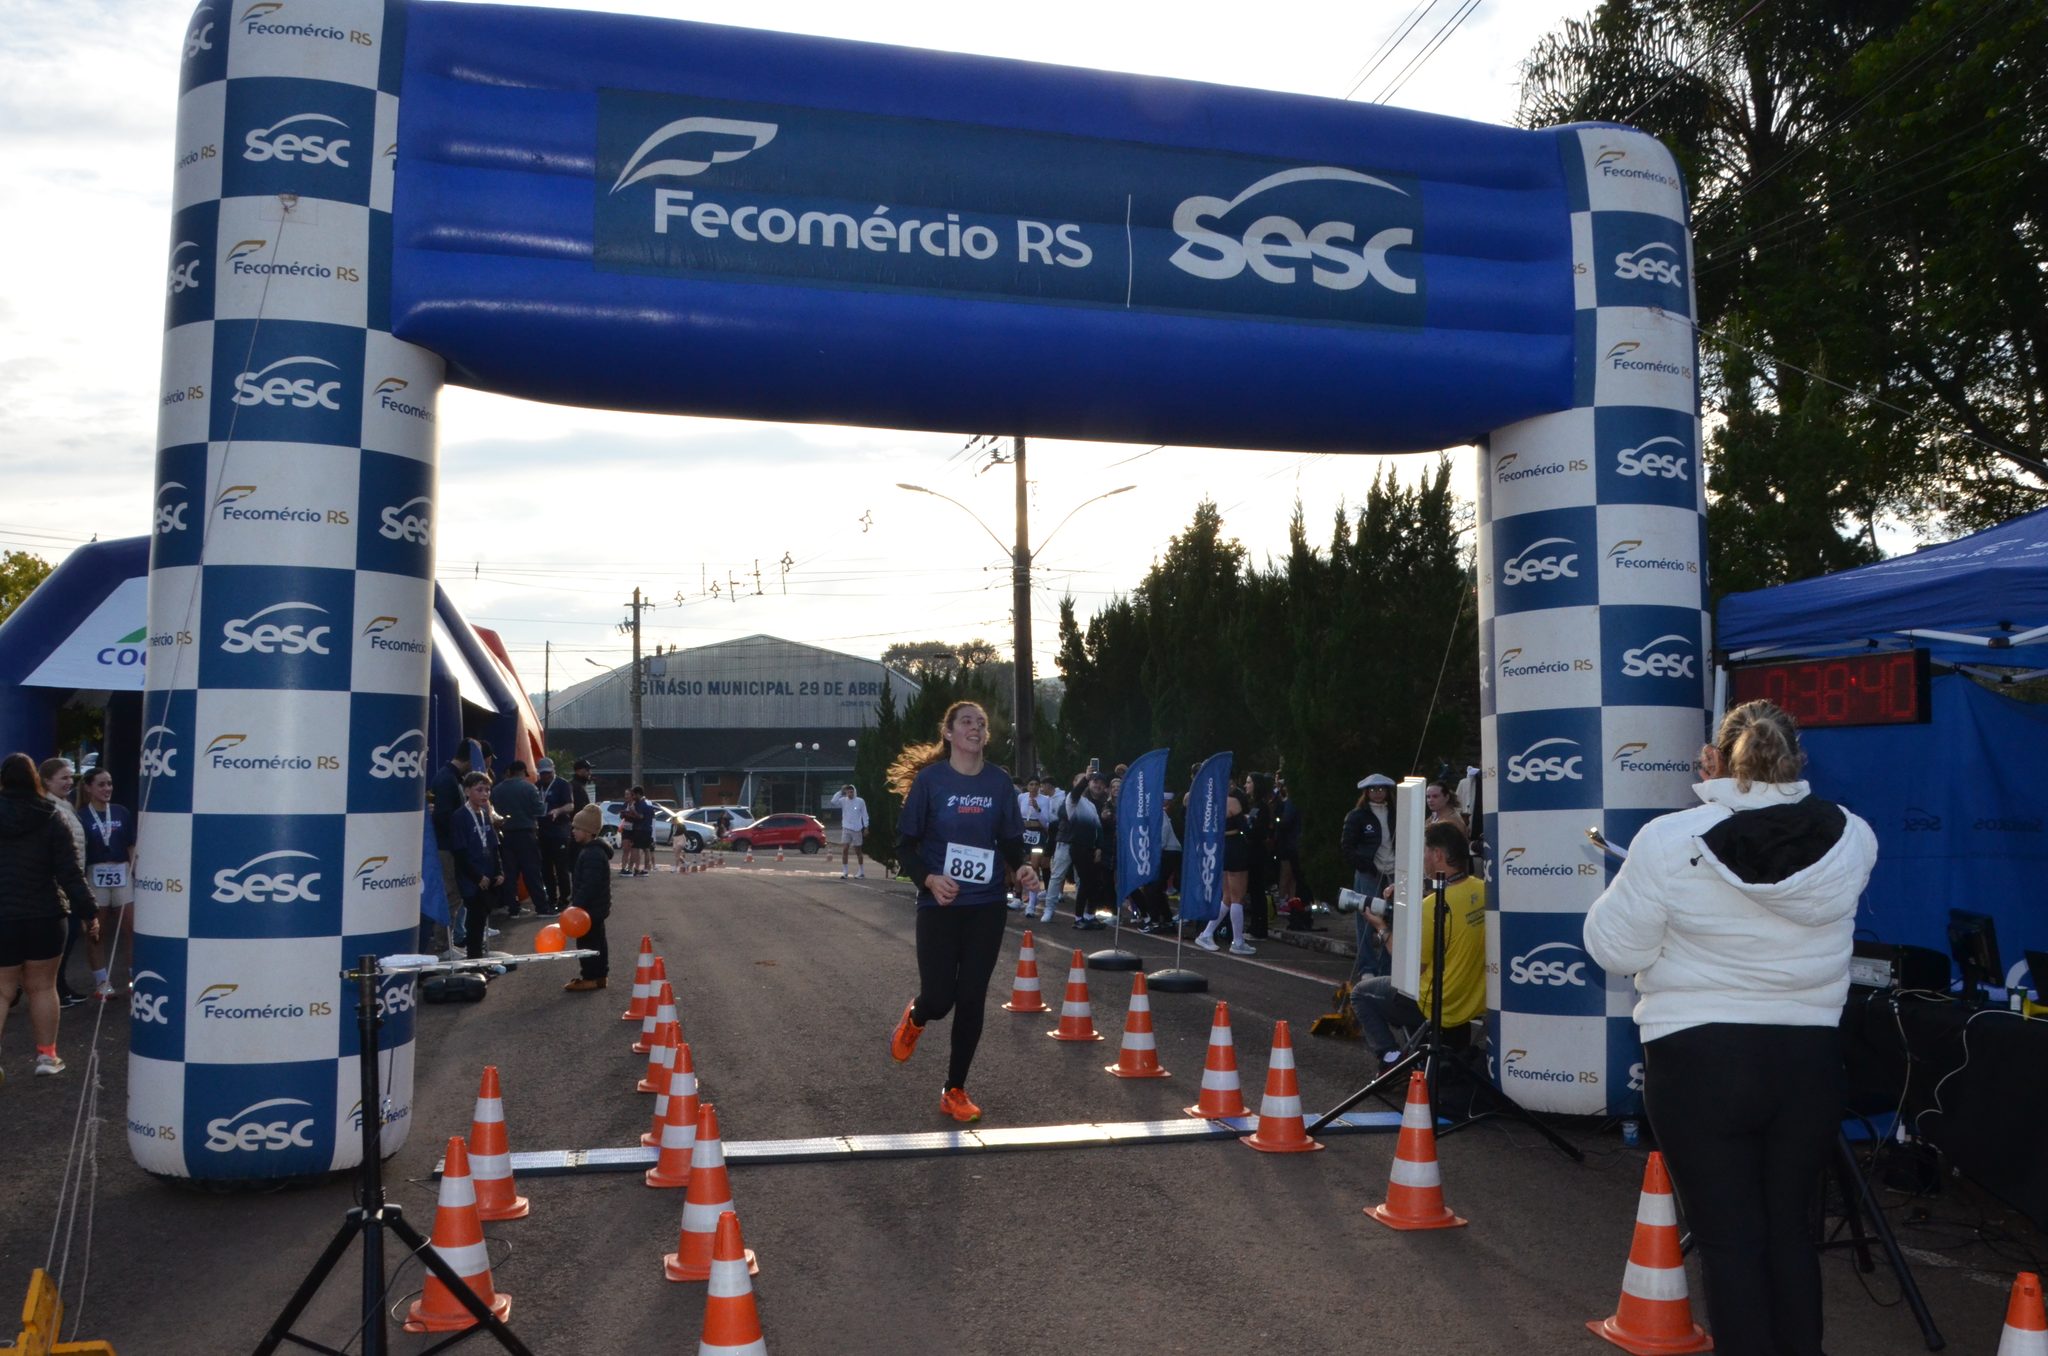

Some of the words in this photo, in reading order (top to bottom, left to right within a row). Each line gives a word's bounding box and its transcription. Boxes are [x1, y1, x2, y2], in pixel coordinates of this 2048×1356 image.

[247, 21, 345, 41] Fecomércio
[349, 30, 373, 47] RS
[201, 144, 217, 160] RS
[242, 127, 350, 168] Sesc
[1603, 166, 1668, 185] Fecomércio
[654, 187, 999, 260] Fecomércio
[1016, 219, 1094, 269] RS
[1168, 194, 1418, 295] Sesc
[233, 260, 331, 280] Fecomércio
[336, 265, 360, 283] RS
[1613, 251, 1683, 289] Sesc
[1613, 358, 1680, 376] Fecomércio
[187, 385, 204, 400] RS
[231, 371, 341, 412] Sesc
[1498, 460, 1565, 484] Fecomércio
[1568, 458, 1589, 472] RS
[1615, 447, 1689, 481] Sesc
[222, 505, 322, 524] Fecomércio
[326, 510, 350, 526] RS
[378, 505, 432, 546] Ses
[1502, 554, 1579, 587] Sesc
[1615, 556, 1685, 572] Fecomércio
[176, 630, 193, 645] RS
[220, 618, 331, 656] Sesc
[1502, 659, 1570, 678] Fecomércio
[1573, 659, 1594, 672] RS
[1620, 648, 1696, 680] Sesc
[639, 677, 704, 696] GINÁSIO
[707, 680, 794, 697] MUNICIPAL
[799, 680, 820, 697] 29
[823, 680, 844, 697] DE
[848, 681, 886, 697] ABRI
[212, 753, 312, 770] Fecomércio
[316, 755, 341, 771] RS
[1506, 754, 1583, 784] Sesc
[1620, 759, 1691, 773] Fecomércio
[97, 873, 122, 886] 753
[950, 857, 987, 882] 882
[1506, 861, 1573, 877] Fecomércio
[1577, 863, 1598, 876] RS
[166, 878, 184, 893] RS
[211, 868, 321, 904] Sesc
[1509, 955, 1586, 987] Sesc
[204, 1003, 304, 1020] Fecomércio
[309, 1001, 332, 1017] RS
[1507, 1065, 1575, 1084] Fecomércio
[1578, 1071, 1599, 1085] RS
[159, 1125, 177, 1141] RS
[204, 1117, 314, 1153] Sesc
